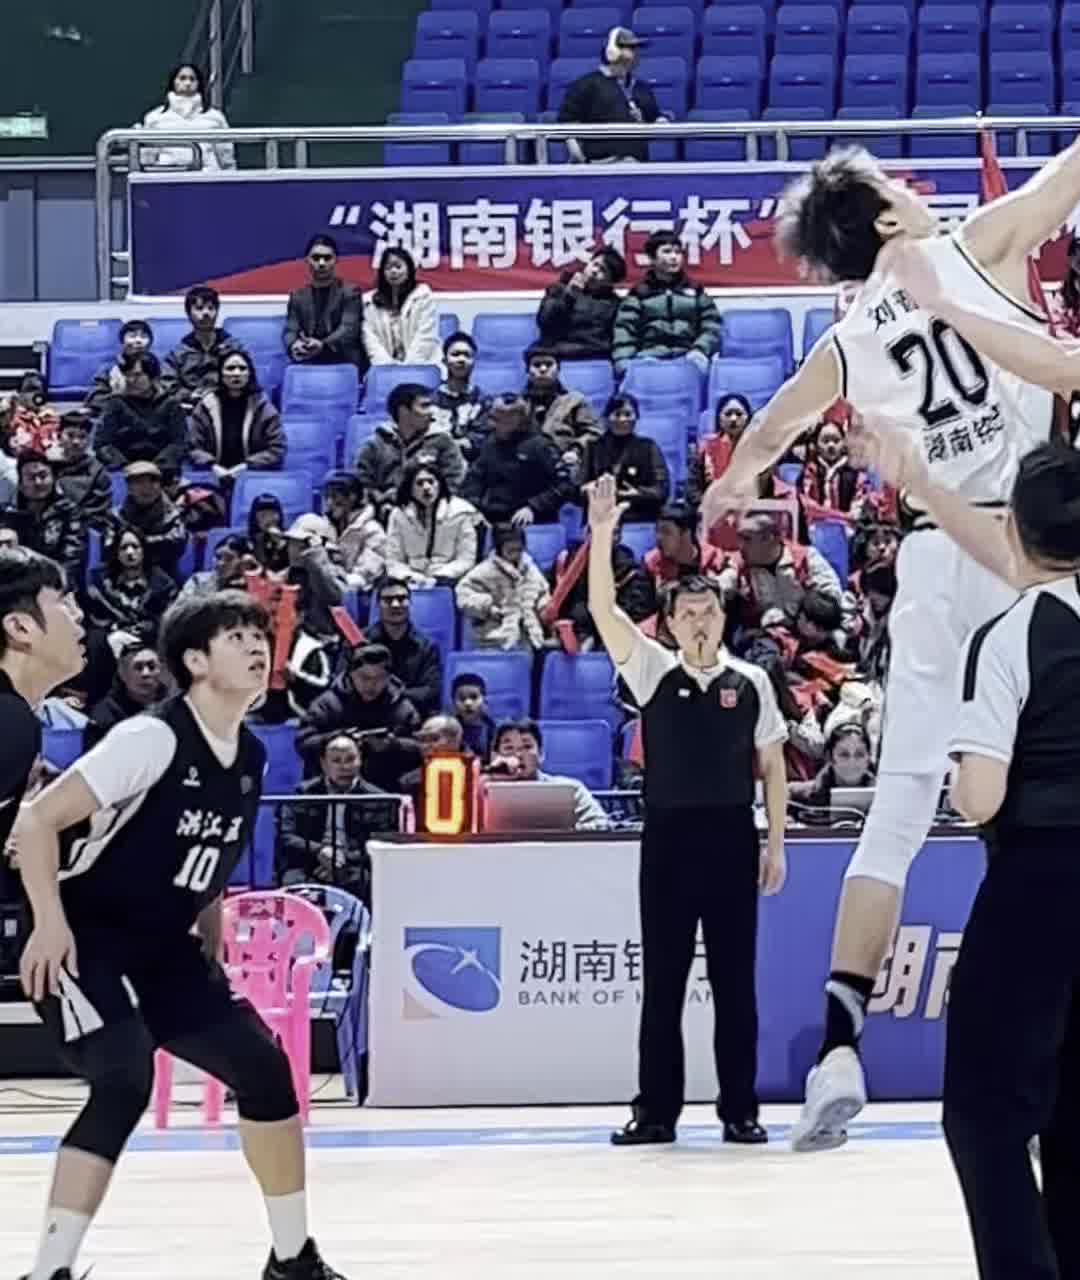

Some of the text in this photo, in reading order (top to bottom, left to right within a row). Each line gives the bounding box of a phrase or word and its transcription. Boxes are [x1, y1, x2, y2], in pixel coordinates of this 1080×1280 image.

[886, 317, 990, 431] 20
[426, 757, 466, 835] 0
[173, 844, 220, 892] 10
[517, 988, 582, 1006] BANK
[592, 988, 625, 1006] OF
